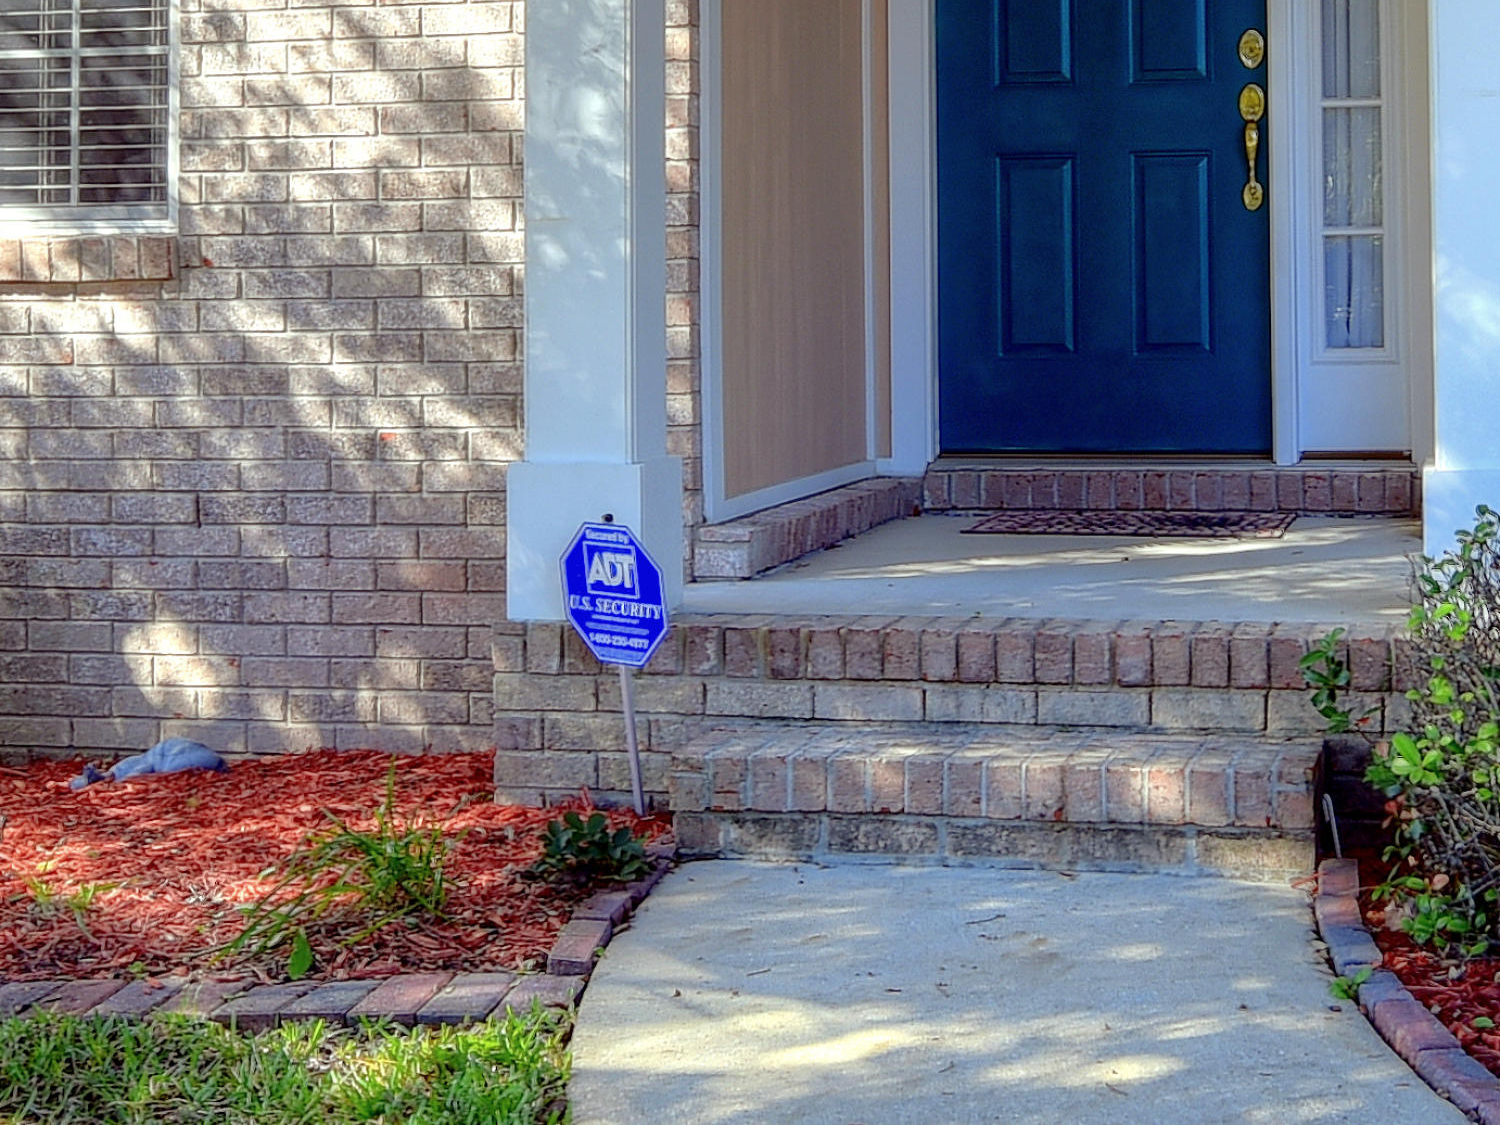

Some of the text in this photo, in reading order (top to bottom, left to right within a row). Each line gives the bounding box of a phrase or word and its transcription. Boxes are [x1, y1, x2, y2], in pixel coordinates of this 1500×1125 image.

[618, 532, 630, 545] by
[588, 551, 634, 589] ADT
[570, 594, 662, 619] U.S. SECURITY
